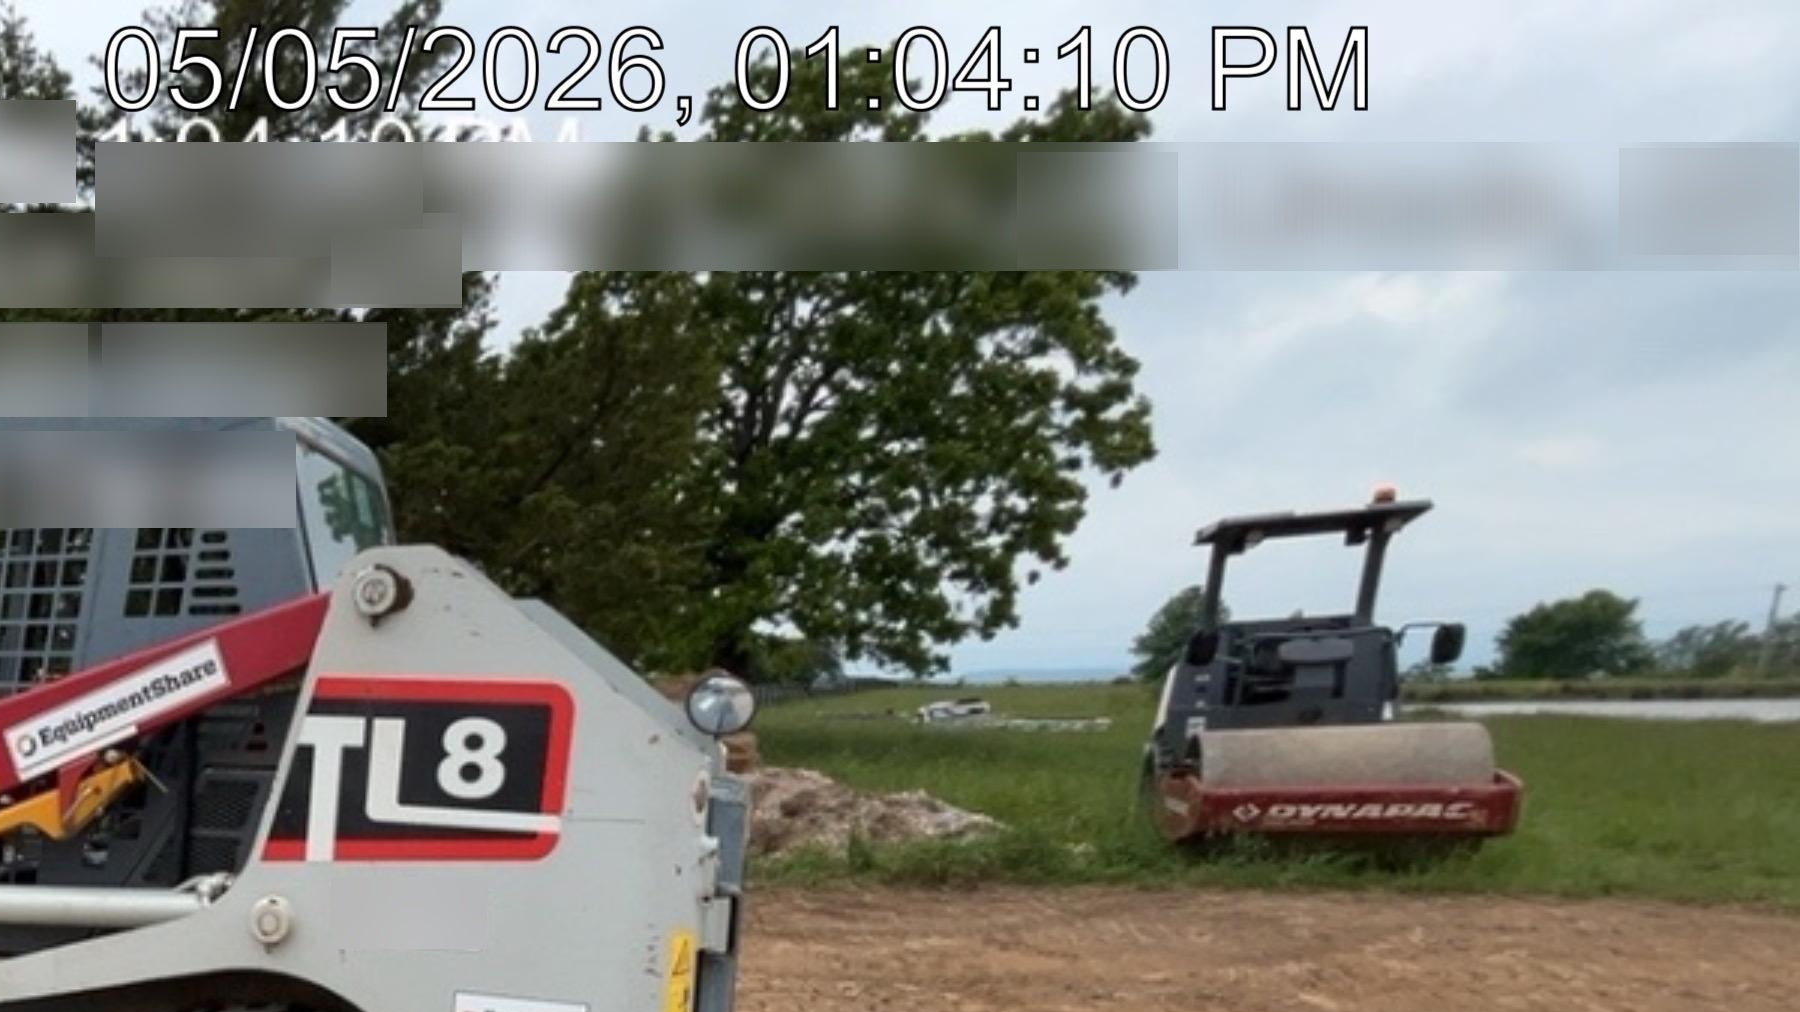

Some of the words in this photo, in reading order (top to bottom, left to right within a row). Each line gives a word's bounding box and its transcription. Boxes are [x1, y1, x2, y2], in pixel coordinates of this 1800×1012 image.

[37, 658, 218, 748] EquipmentShare
[295, 714, 562, 862] TL8
[1267, 801, 1477, 820] DYNAPAC
